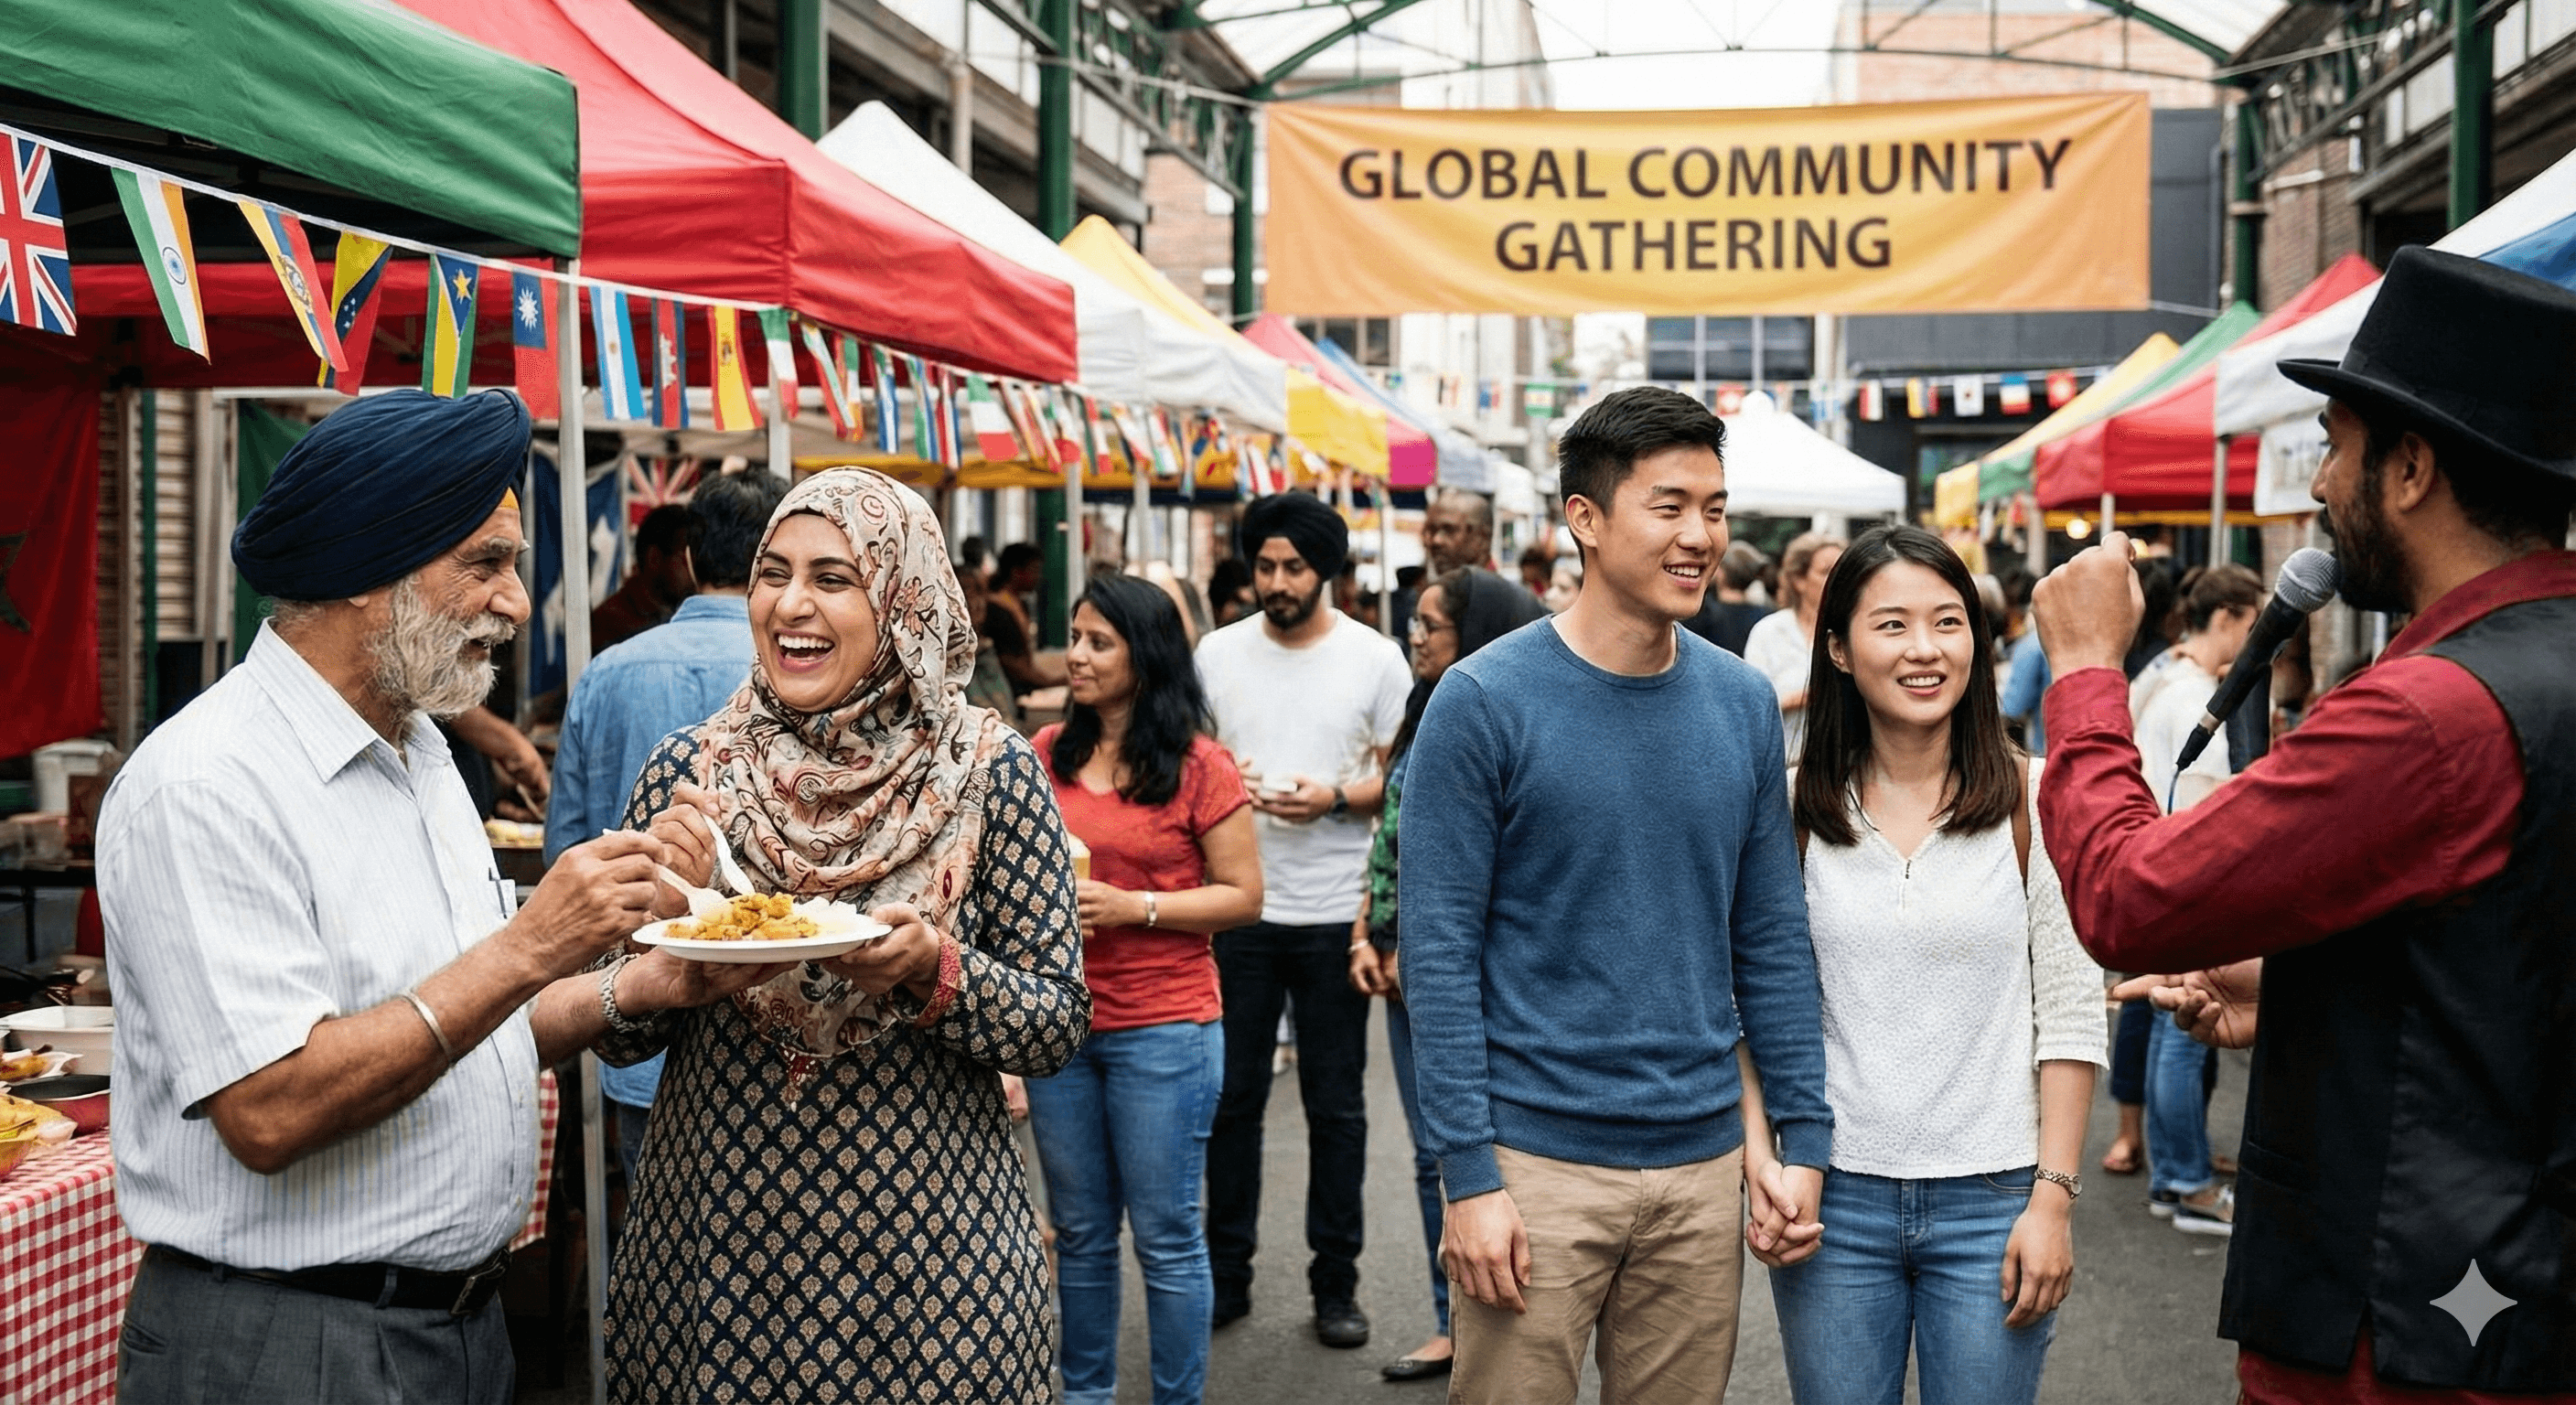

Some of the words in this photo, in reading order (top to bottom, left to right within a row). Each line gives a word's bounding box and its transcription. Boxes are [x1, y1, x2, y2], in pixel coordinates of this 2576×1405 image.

[1339, 148, 1606, 200] GLOBAL
[1628, 138, 2075, 198] COMMUNITY
[1495, 218, 1891, 273] GATHERING
